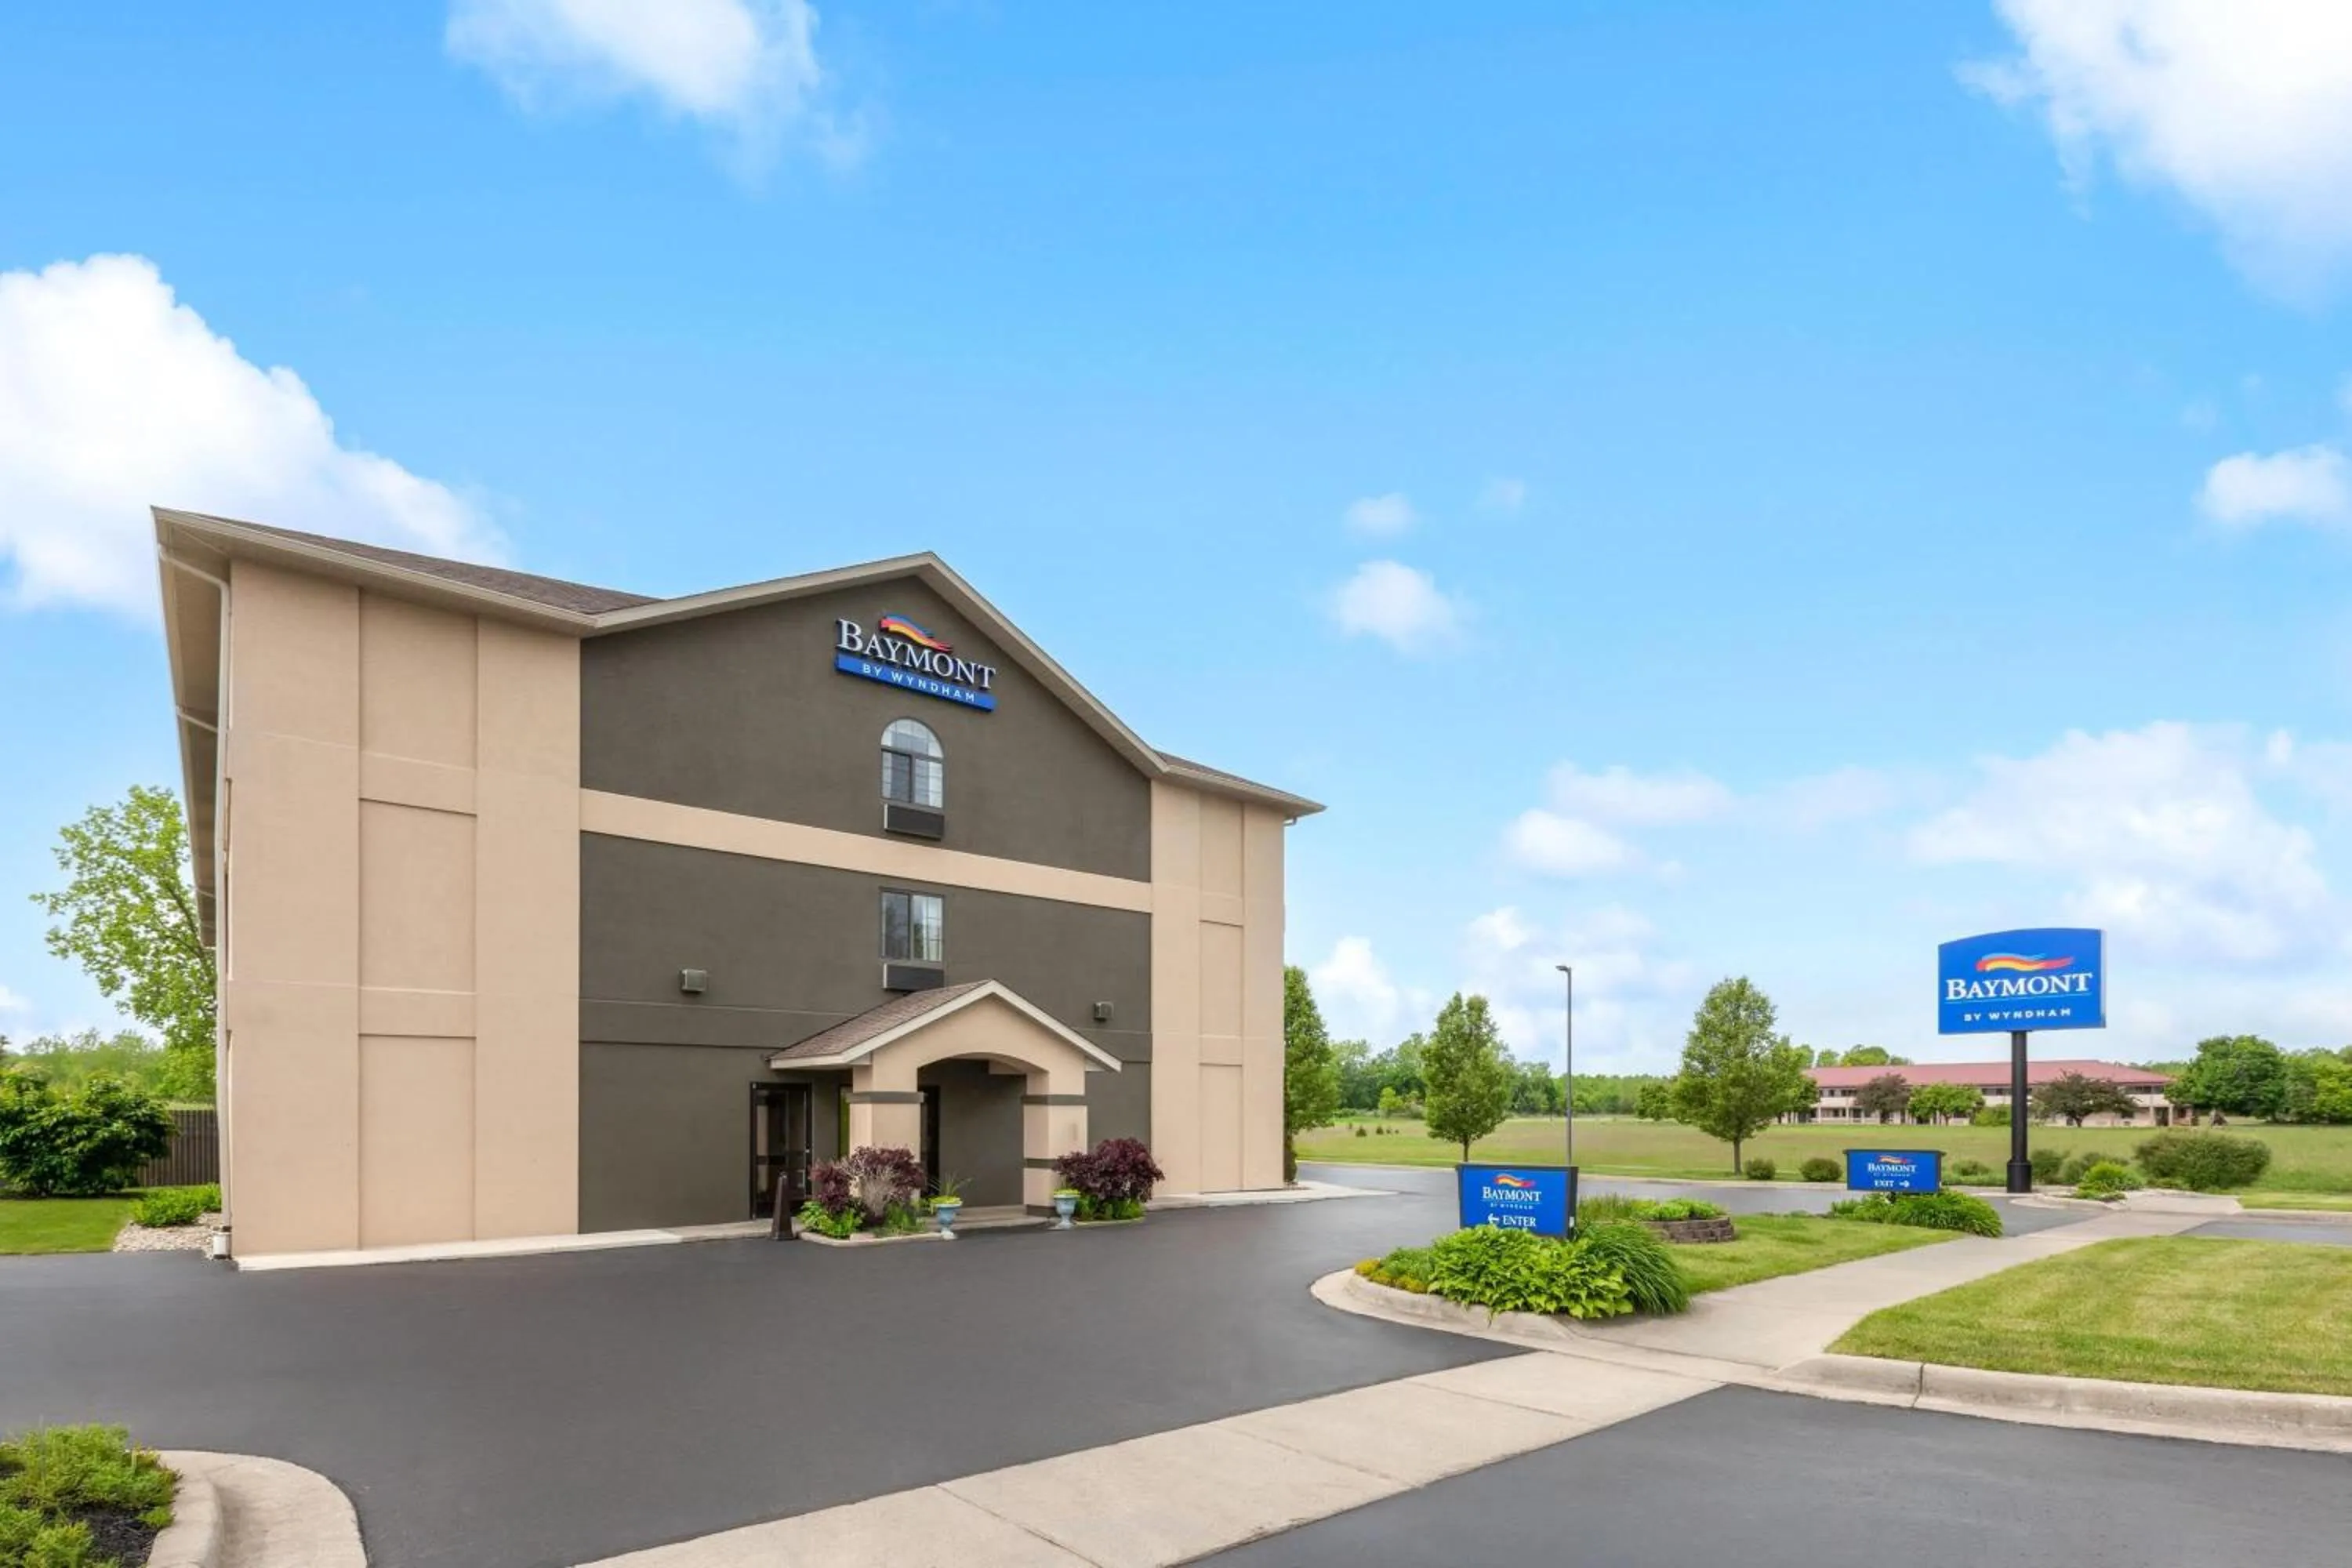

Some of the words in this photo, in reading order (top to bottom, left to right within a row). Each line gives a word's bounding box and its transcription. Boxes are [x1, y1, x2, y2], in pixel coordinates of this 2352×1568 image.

[837, 618, 996, 689] BAYMONT
[863, 662, 883, 677] BY
[891, 670, 975, 702] WYNDHAM
[1945, 972, 2093, 1000] BAYMONT
[1964, 1013, 1981, 1022] BY
[1989, 1008, 2071, 1020] WYNDHAM
[1867, 1163, 1918, 1173] BAYMONT
[1483, 1186, 1541, 1202] BAYMONT
[1503, 1214, 1537, 1227] ENTER
